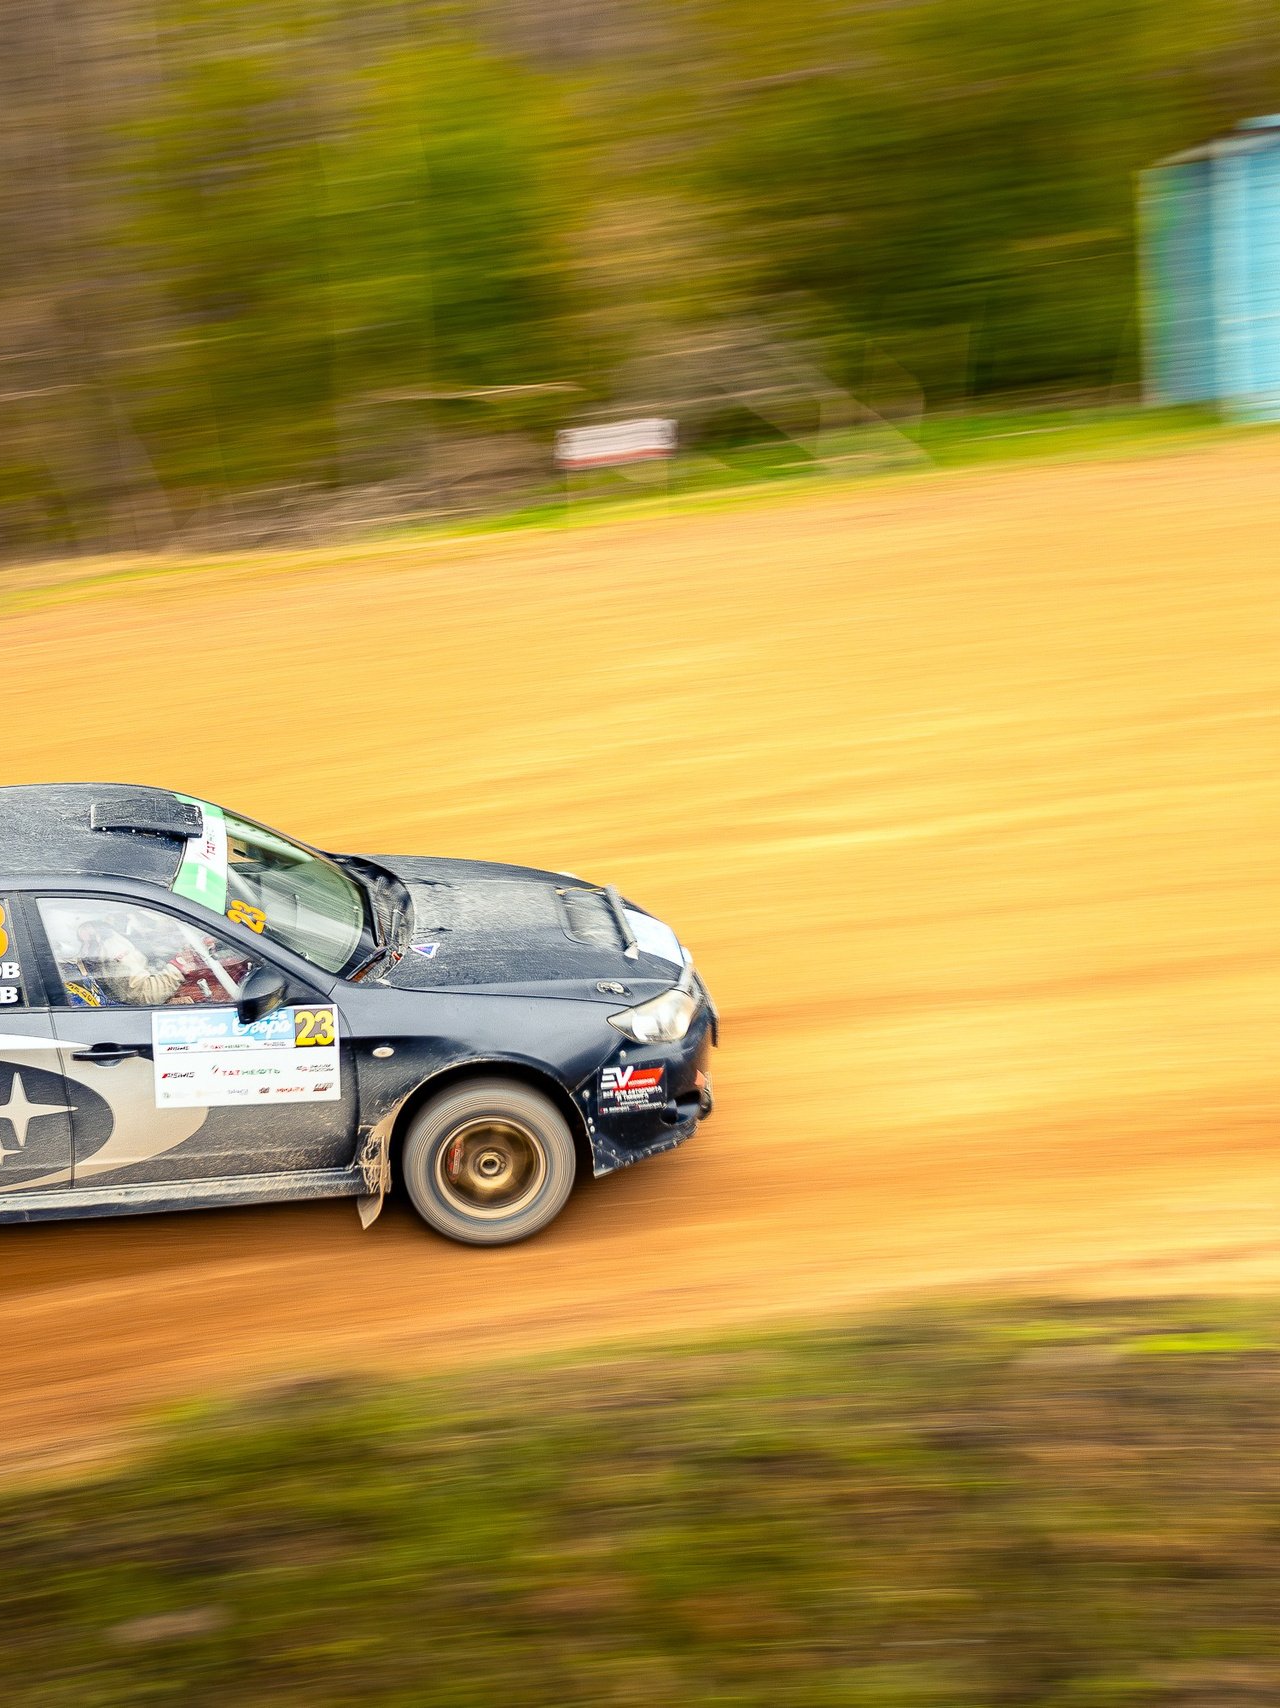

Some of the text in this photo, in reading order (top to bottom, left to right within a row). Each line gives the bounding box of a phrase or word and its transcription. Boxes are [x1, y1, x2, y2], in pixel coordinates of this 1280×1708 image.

[227, 899, 267, 934] 23
[294, 1010, 335, 1047] 23
[601, 1065, 635, 1090] EV
